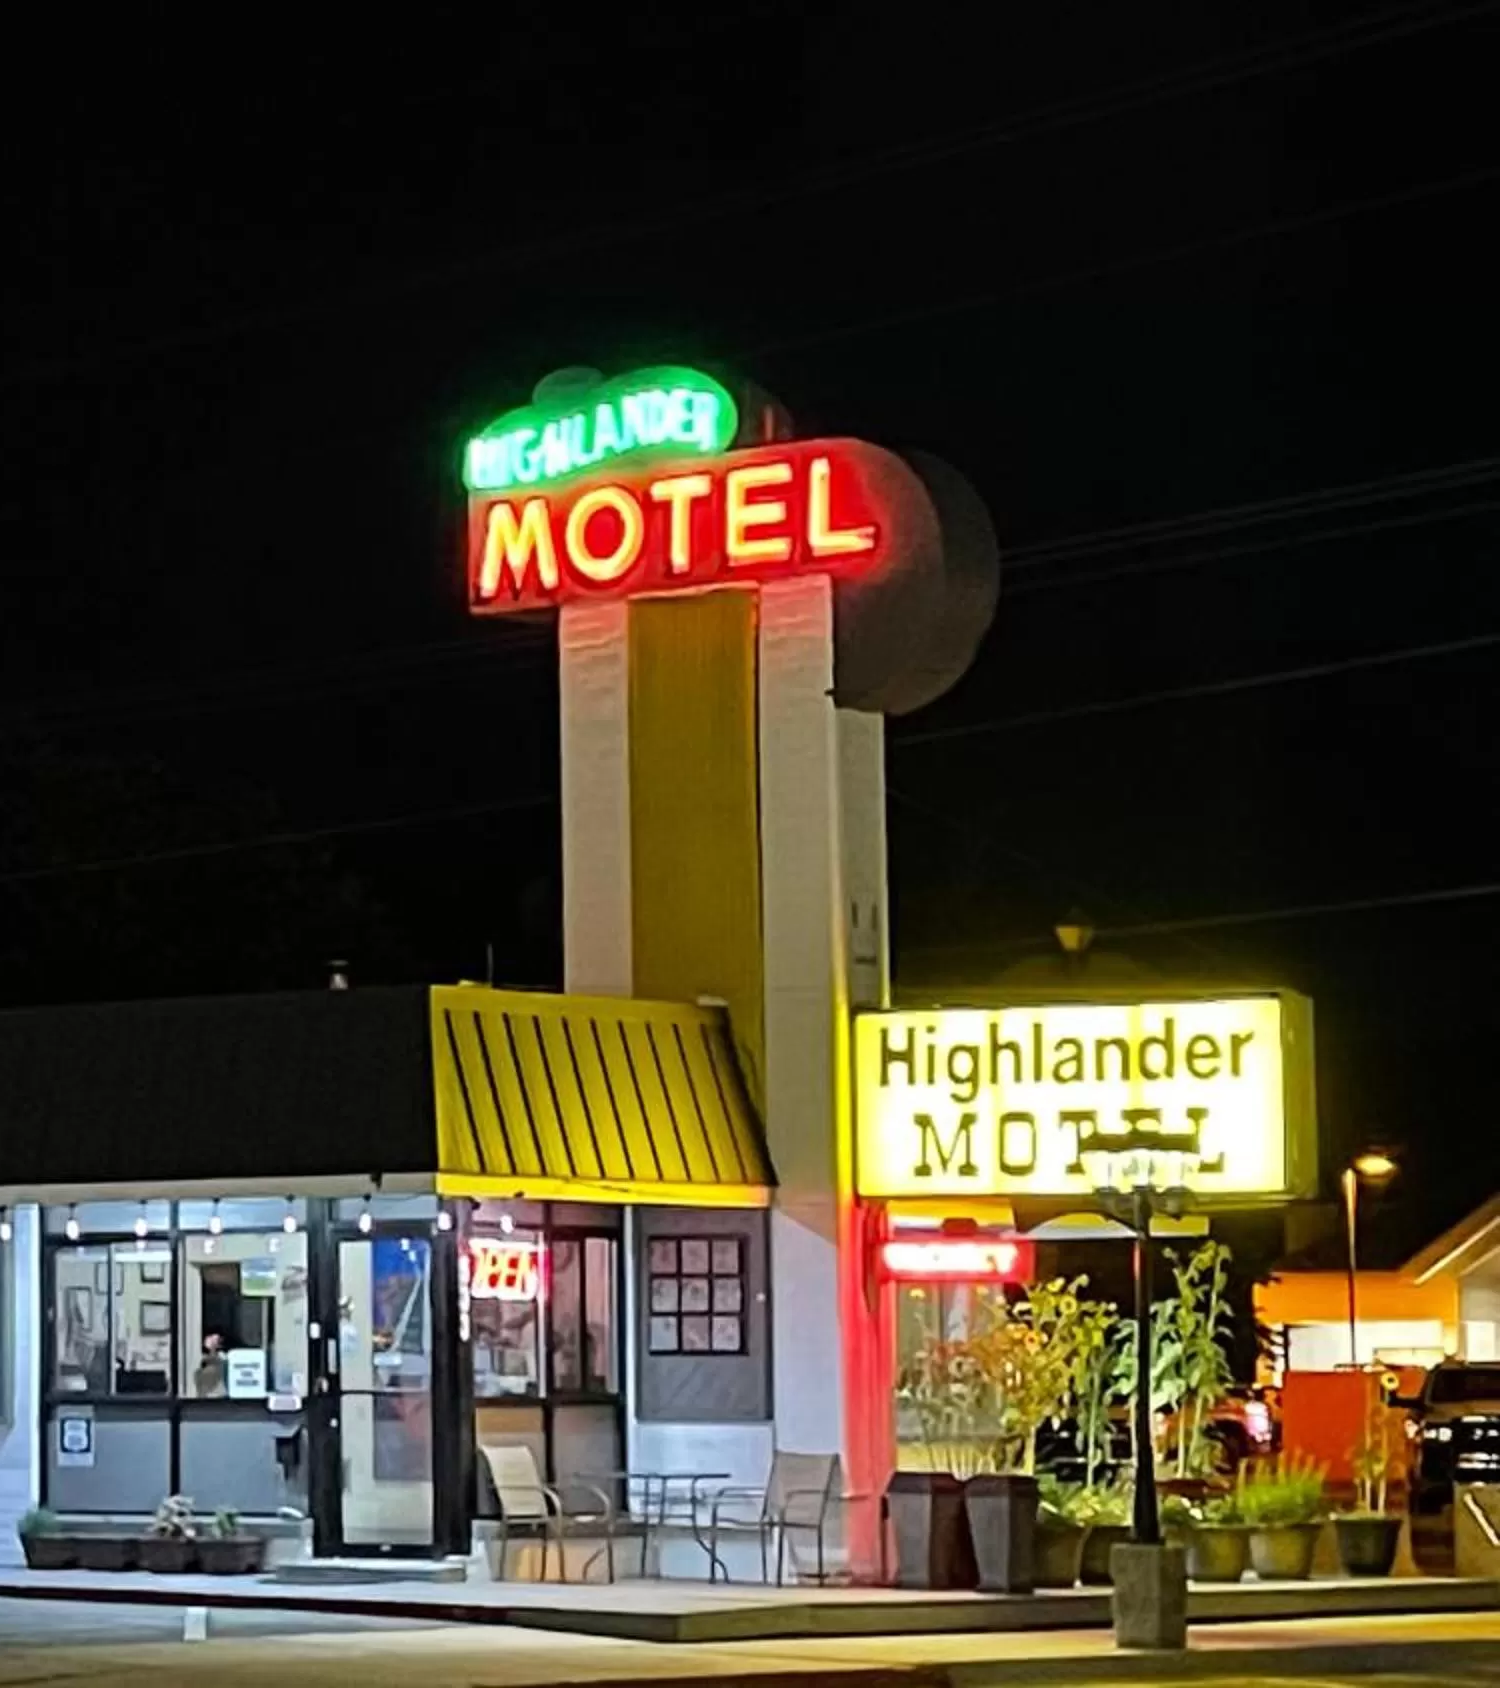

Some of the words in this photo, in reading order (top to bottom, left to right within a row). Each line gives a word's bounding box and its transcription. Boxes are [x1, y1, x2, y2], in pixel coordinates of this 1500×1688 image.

[469, 388, 720, 488] HIGHLANDER
[479, 457, 877, 598] MOTEL
[879, 1016, 1255, 1103] Highlander
